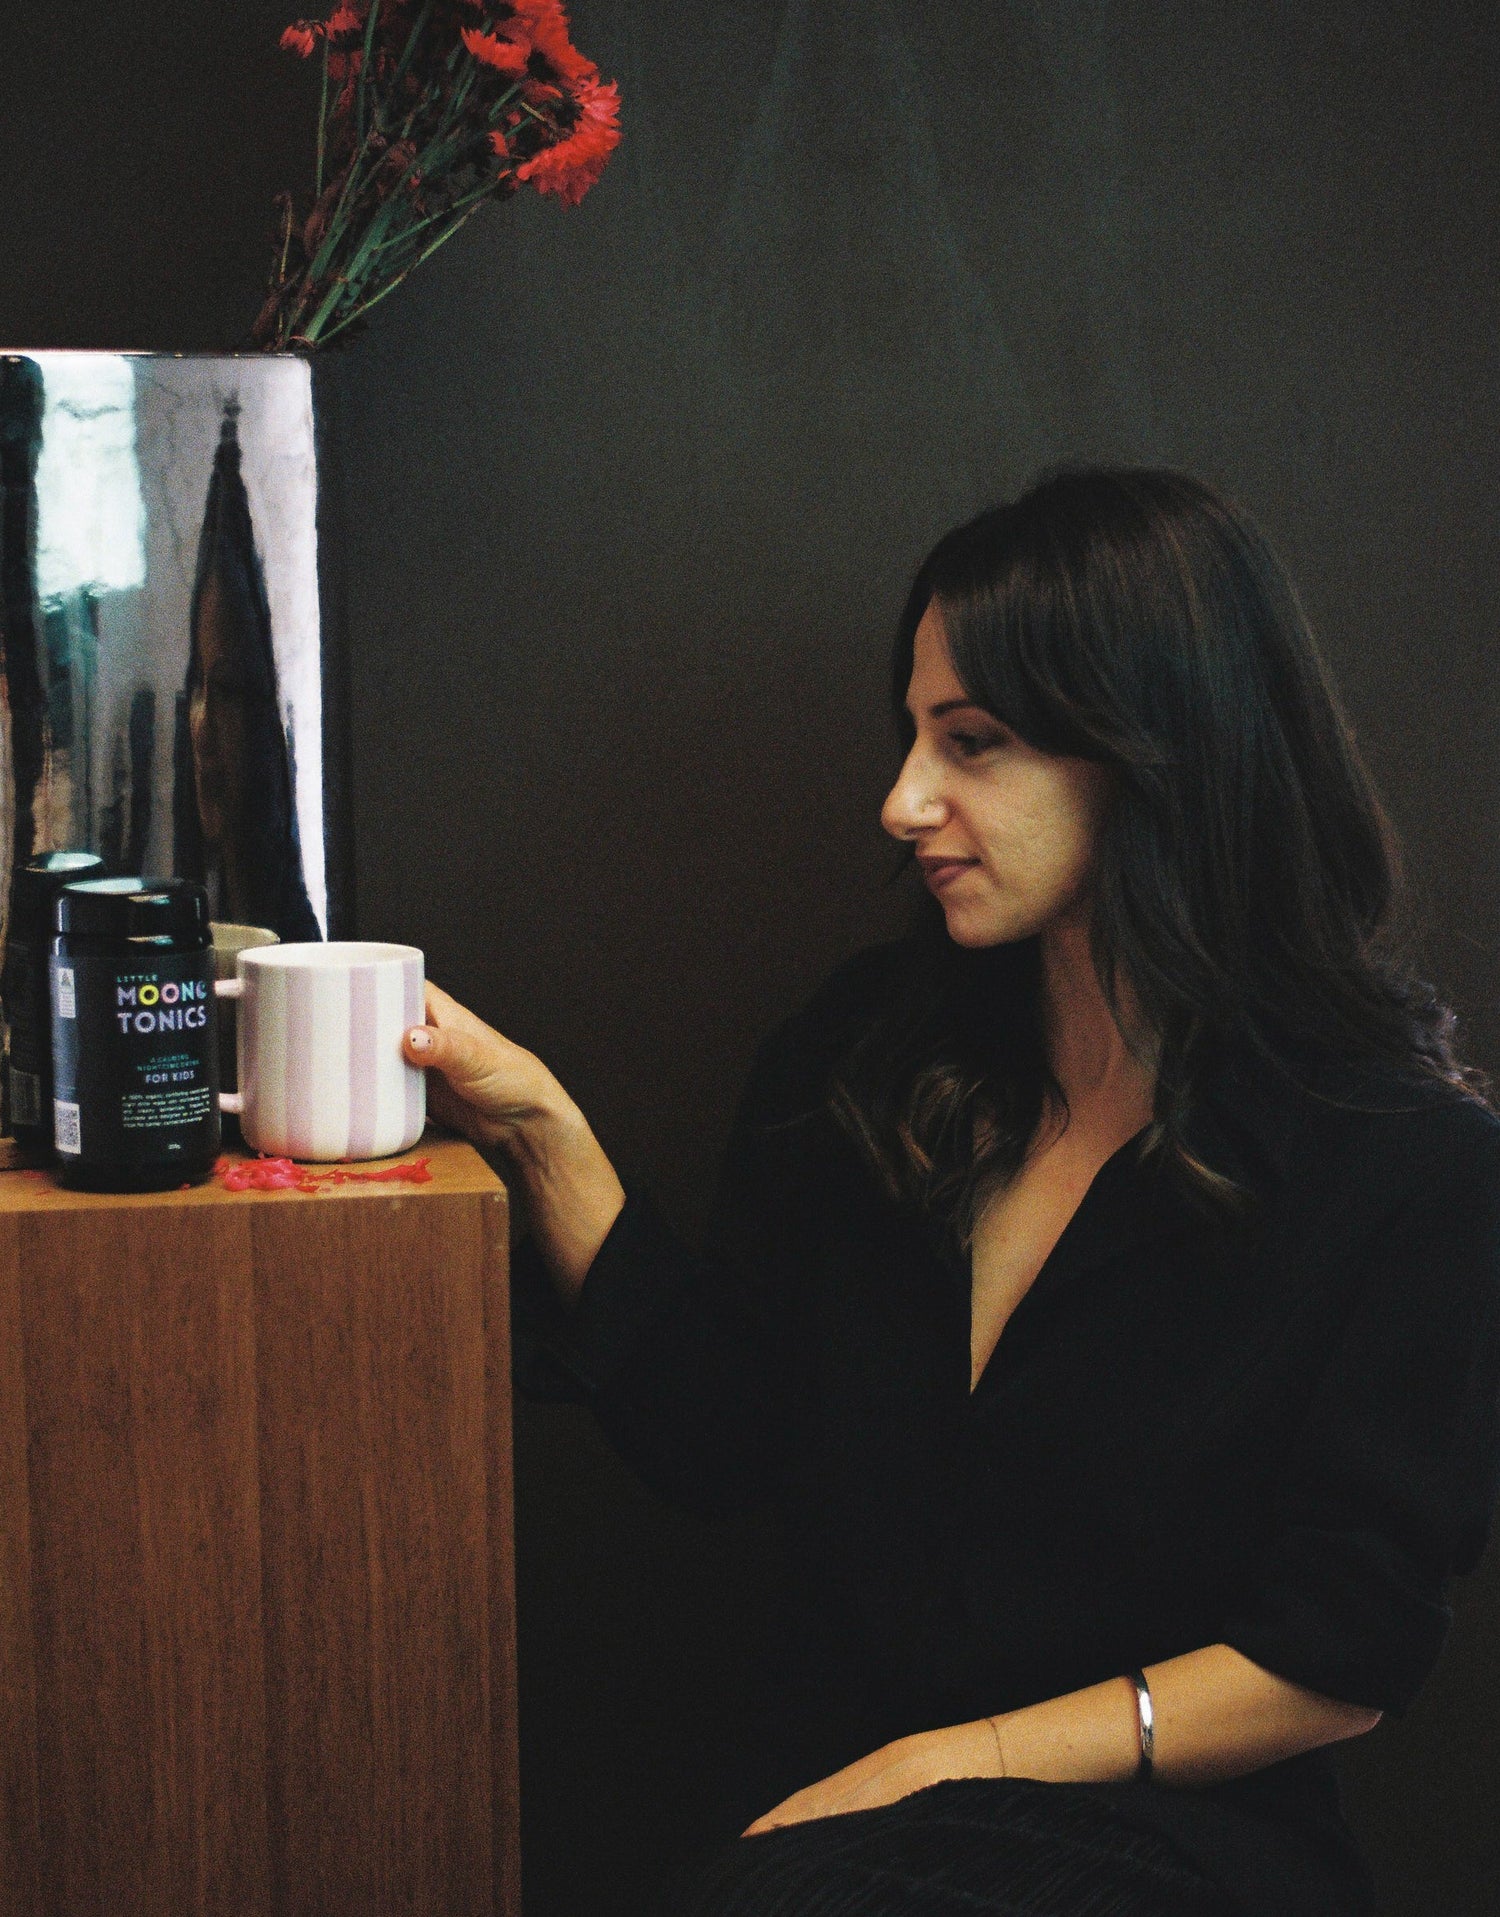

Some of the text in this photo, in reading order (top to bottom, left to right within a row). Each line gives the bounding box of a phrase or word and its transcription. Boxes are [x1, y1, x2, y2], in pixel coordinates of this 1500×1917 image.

[116, 974, 158, 983] LITTLE
[117, 1005, 206, 1034] TONICS
[145, 1070, 195, 1084] FOR KIDS
